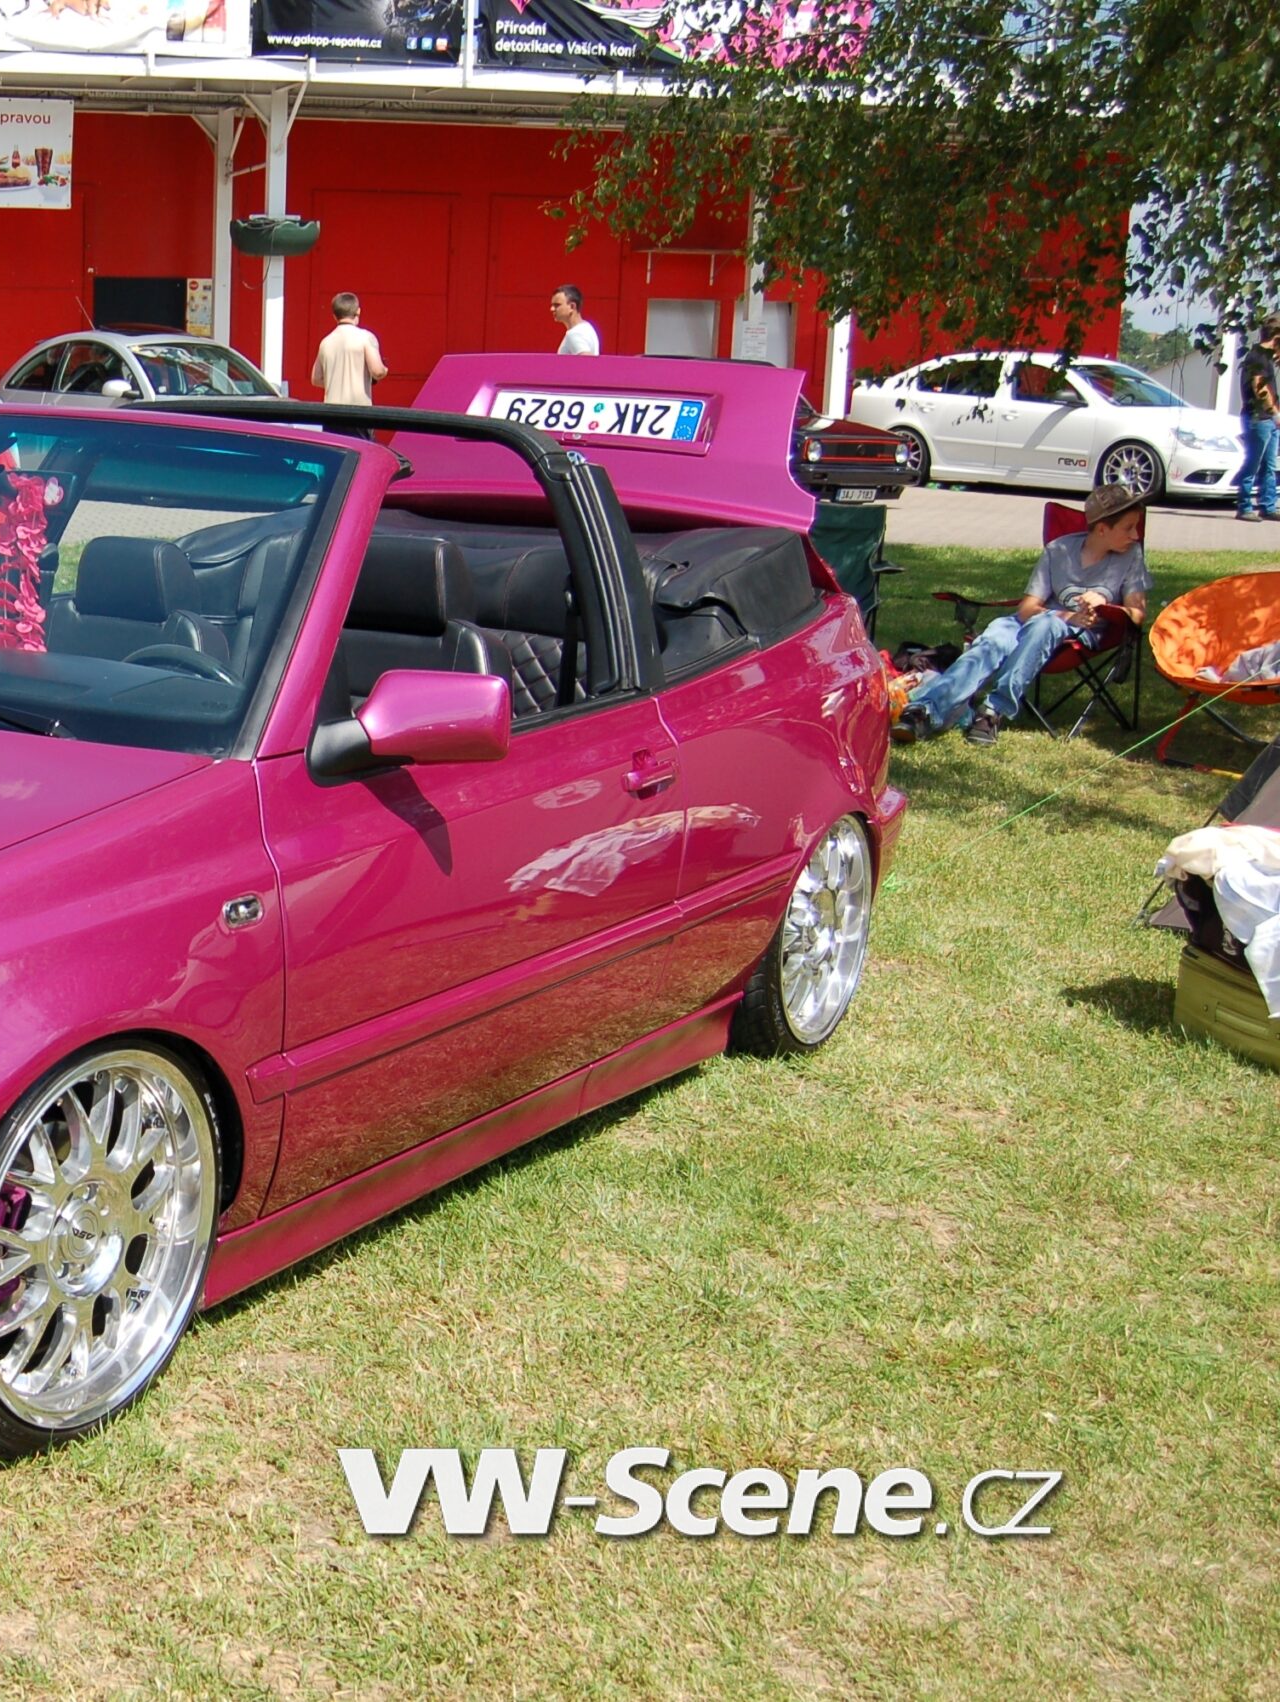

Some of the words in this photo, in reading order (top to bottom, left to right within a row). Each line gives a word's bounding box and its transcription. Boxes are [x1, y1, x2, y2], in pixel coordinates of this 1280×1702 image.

[495, 20, 547, 36] Přírodní
[267, 33, 382, 48] www.galopp-reporter.cz
[494, 38, 564, 54] detoxikace
[0, 112, 51, 126] pravou
[505, 397, 585, 430] 6829
[607, 402, 671, 435] 2AK
[681, 406, 698, 417] CZ
[1057, 457, 1087, 467] revo
